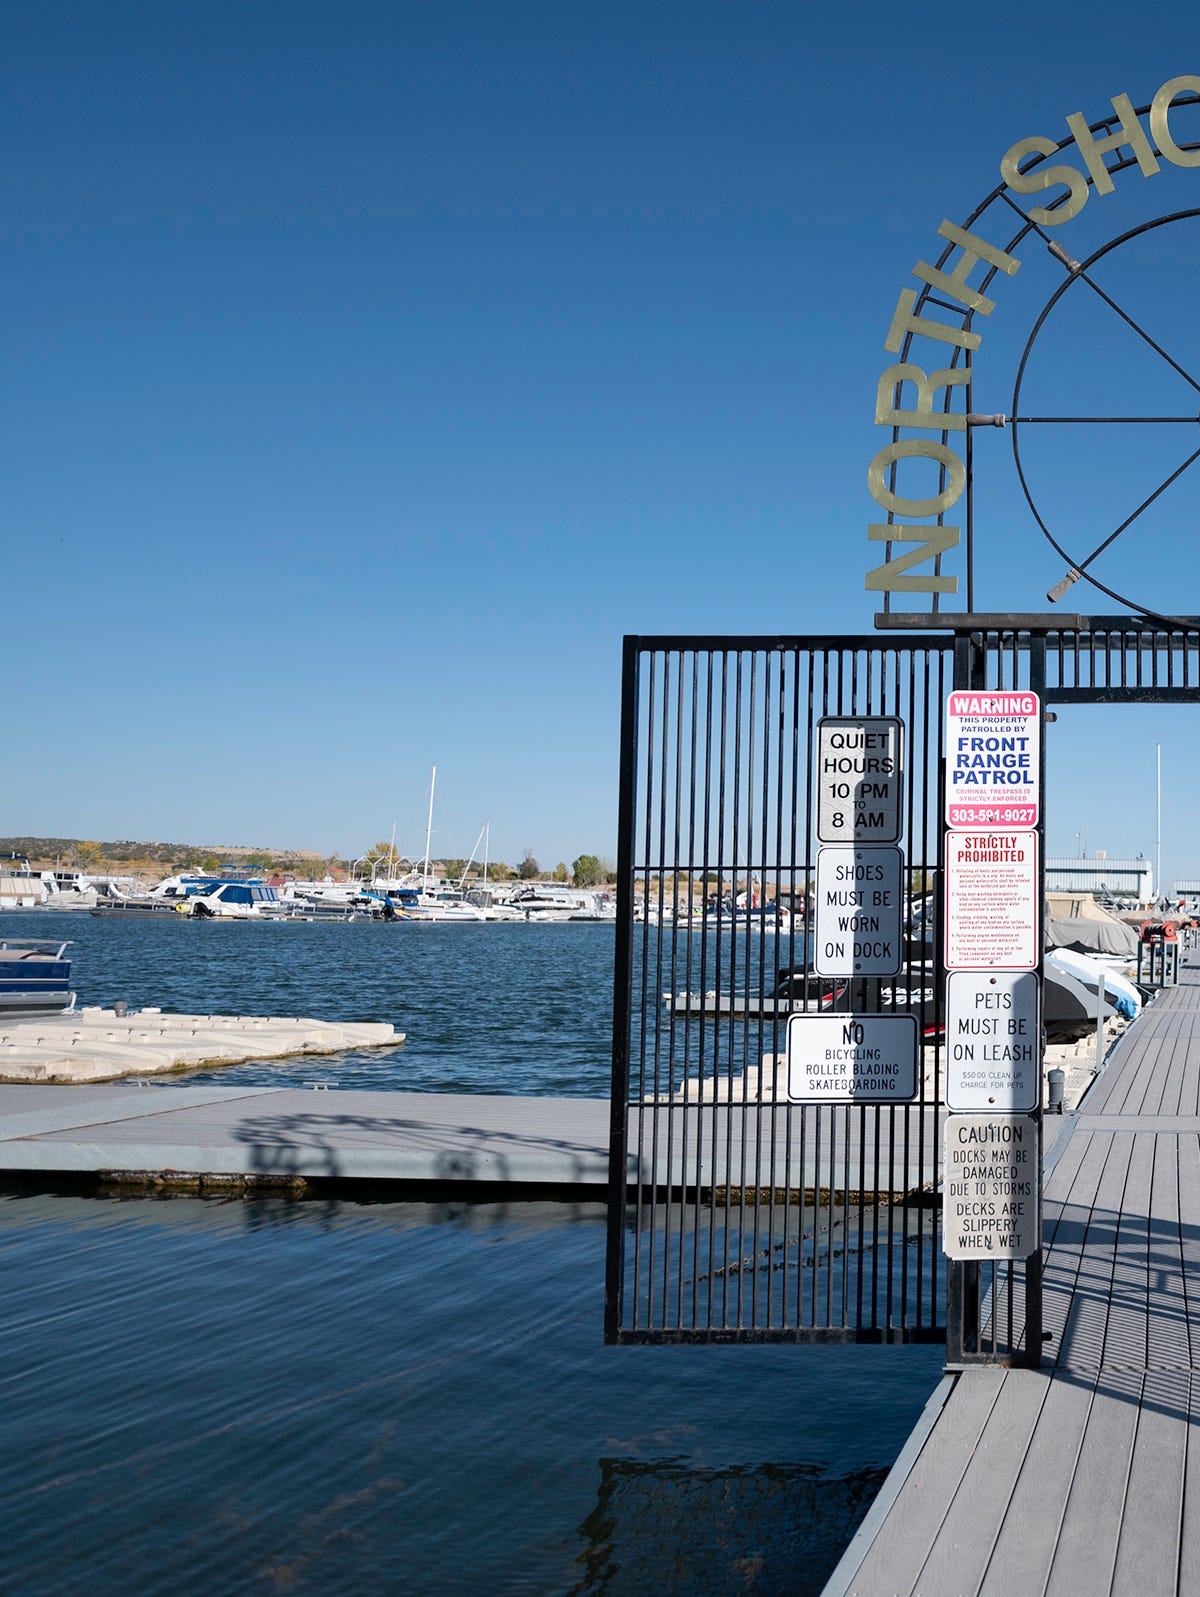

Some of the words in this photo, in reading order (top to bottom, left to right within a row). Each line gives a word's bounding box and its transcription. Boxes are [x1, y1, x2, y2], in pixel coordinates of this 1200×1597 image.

[864, 219, 1022, 593] NORTH
[954, 698, 1033, 714] WARNING
[830, 734, 889, 749] QUIET
[958, 737, 1029, 751] FRONT
[824, 758, 893, 773] HOURS
[957, 754, 1030, 768] RANGE
[953, 771, 1034, 784] PATROL
[829, 783, 850, 798] 10
[861, 784, 888, 798] PM
[853, 801, 866, 809] TO
[832, 813, 844, 827] 8
[855, 813, 884, 827] AM
[965, 837, 1017, 848] STRICTLY
[958, 851, 1024, 862] PROHIBITED
[836, 866, 884, 881] SHOES
[827, 891, 865, 906] MUST
[873, 891, 890, 906] BE
[838, 917, 879, 932] WORN
[825, 942, 844, 958] ON
[853, 942, 891, 958] DOCK
[975, 993, 1012, 1009] PETS
[958, 1019, 999, 1034] MUST
[1008, 1019, 1027, 1035] BE
[843, 1024, 864, 1045] NO
[826, 1049, 881, 1060] BICYCLING
[954, 1044, 974, 1060] ON
[984, 1045, 1032, 1060] LEASH
[806, 1064, 846, 1075] ROLLER
[853, 1064, 899, 1075] BLADING
[809, 1079, 896, 1090] SKATEBOARDING
[958, 1126, 1022, 1143] CAUTION
[954, 1150, 986, 1163] DOCKS
[992, 1150, 1011, 1163] MAY
[1016, 1150, 1027, 1163] BE
[963, 1167, 1018, 1179] DAMAGED
[950, 1183, 969, 1196] DUE
[975, 1183, 986, 1195] TO
[993, 1182, 1030, 1195] STORMS
[957, 1203, 995, 1216] DECKS
[1002, 1203, 1024, 1215] ARE
[963, 1219, 1018, 1232] SLIPPERY
[958, 1234, 992, 1248] WHEN
[999, 1234, 1022, 1248] WET
